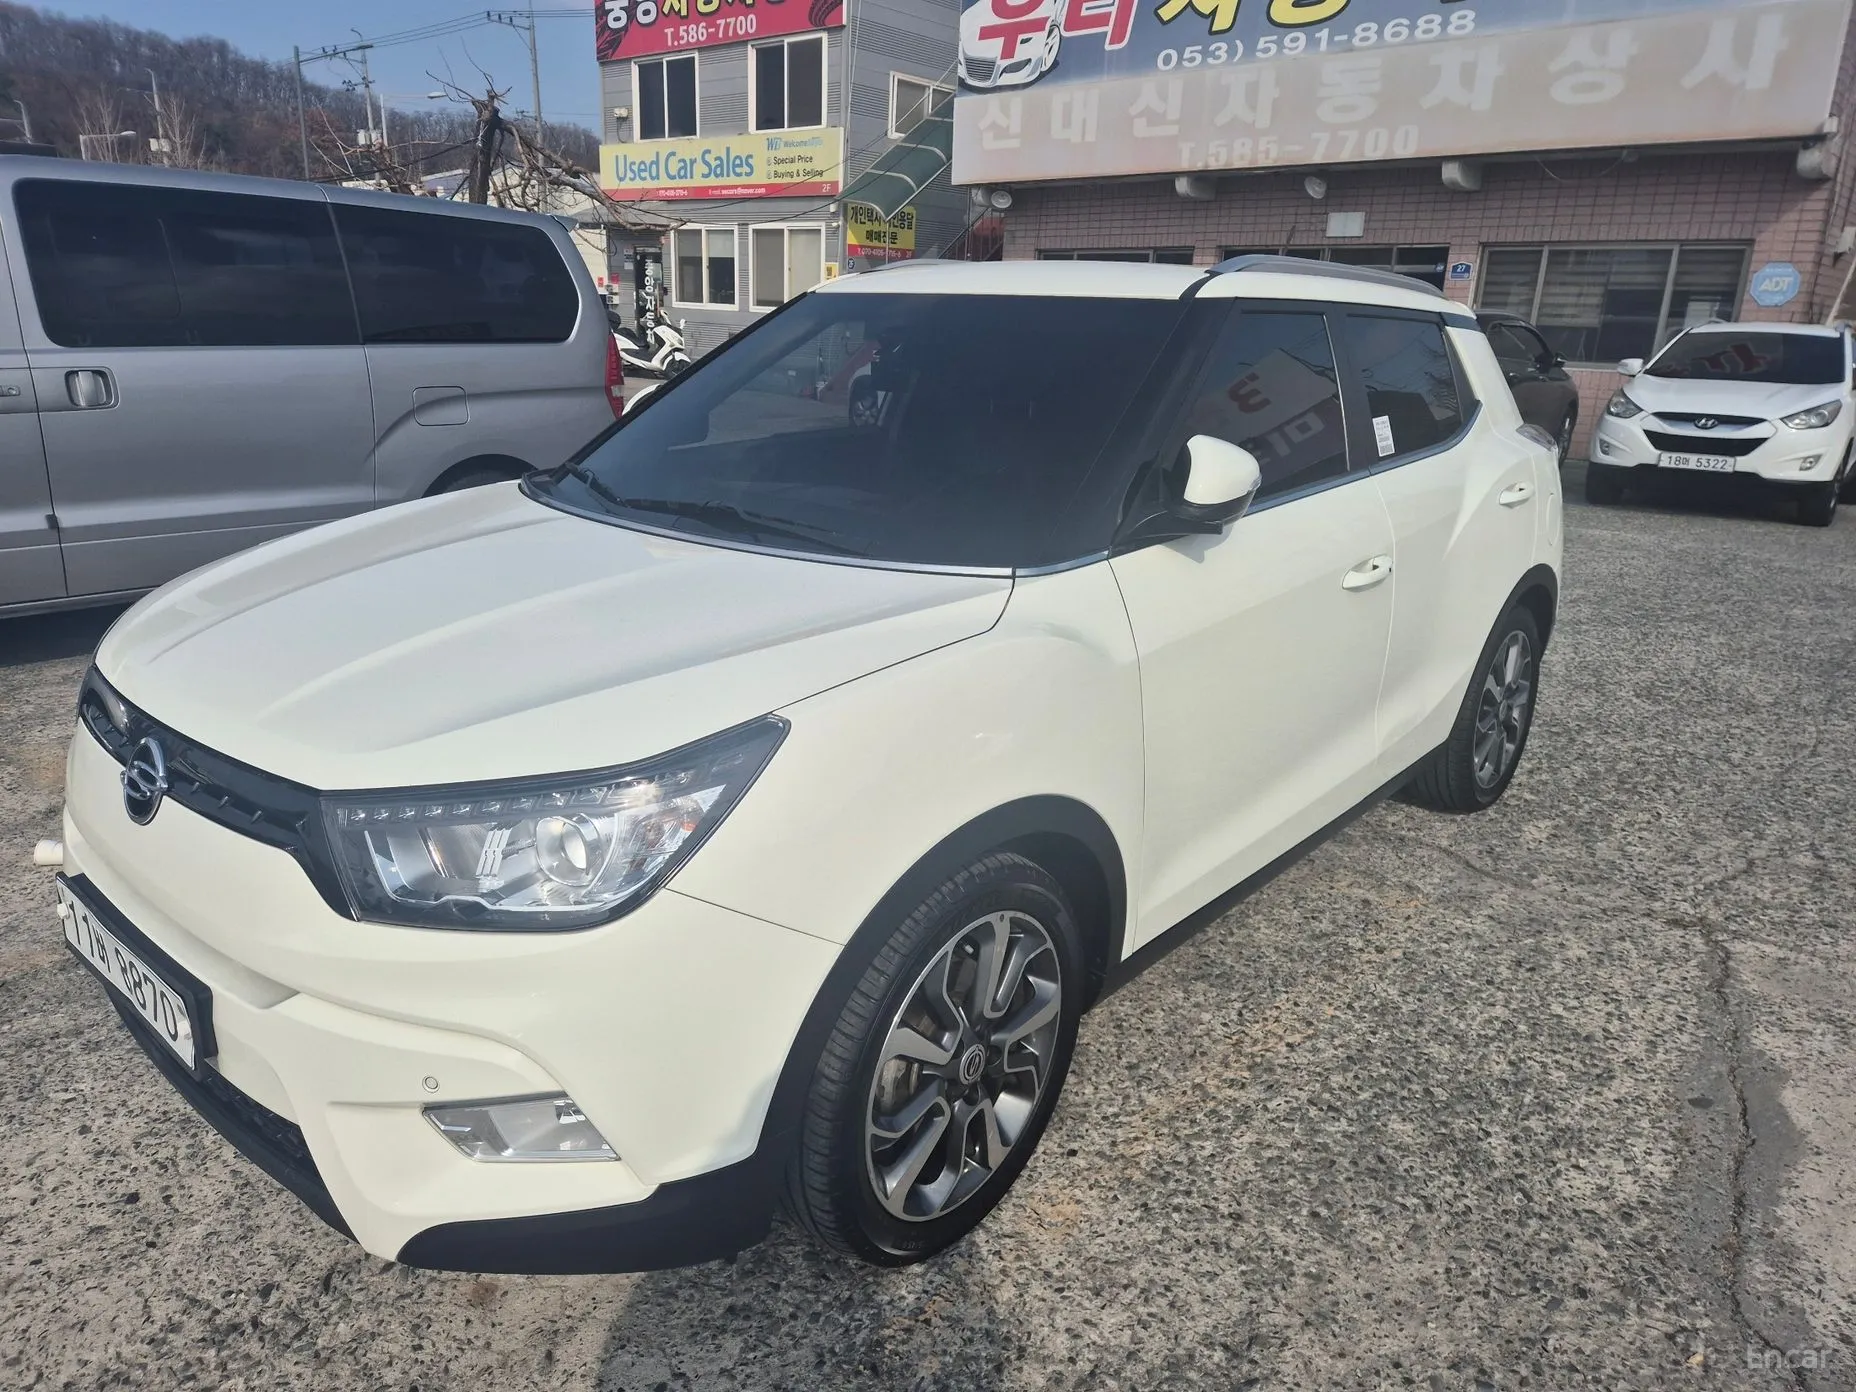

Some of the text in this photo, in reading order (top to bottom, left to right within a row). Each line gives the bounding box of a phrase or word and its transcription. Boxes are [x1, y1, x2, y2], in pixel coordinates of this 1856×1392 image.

[664, 14, 757, 46] T.586-7700
[1156, 39, 1244, 71] 053)
[1256, 9, 1477, 58] 591-8688
[1178, 125, 1419, 170] T.585-7700
[615, 146, 755, 182] Used Car Sales
[773, 154, 813, 166] Special Price
[773, 168, 824, 179] Buying & Selling
[822, 183, 831, 193] 2F
[885, 211, 914, 230] 인용달
[1456, 264, 1466, 273] 27
[1759, 277, 1794, 292] ADT
[1695, 457, 1728, 470] 5322
[114, 947, 179, 1042] 8870
